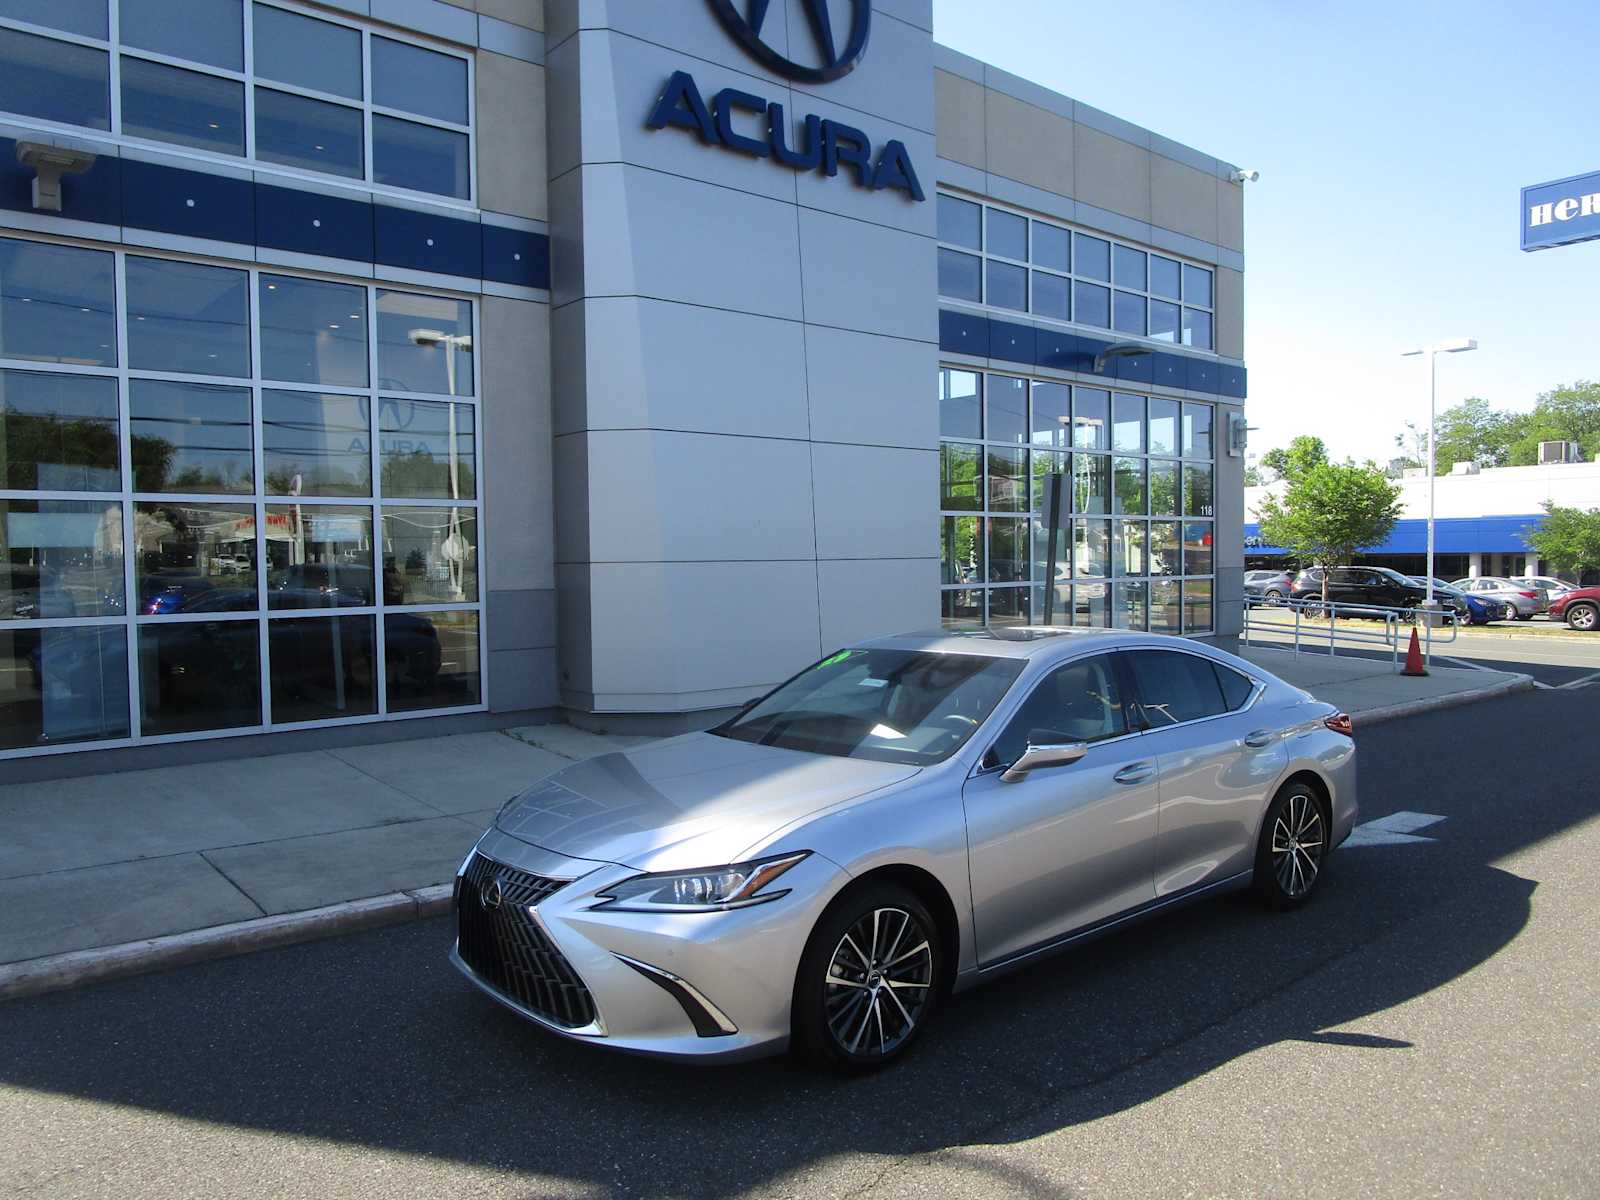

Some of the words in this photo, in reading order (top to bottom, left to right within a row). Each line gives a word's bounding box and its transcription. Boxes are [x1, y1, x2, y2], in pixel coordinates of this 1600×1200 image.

[648, 70, 926, 202] ACURA
[347, 437, 433, 455] AURA
[1200, 505, 1213, 516] 118
